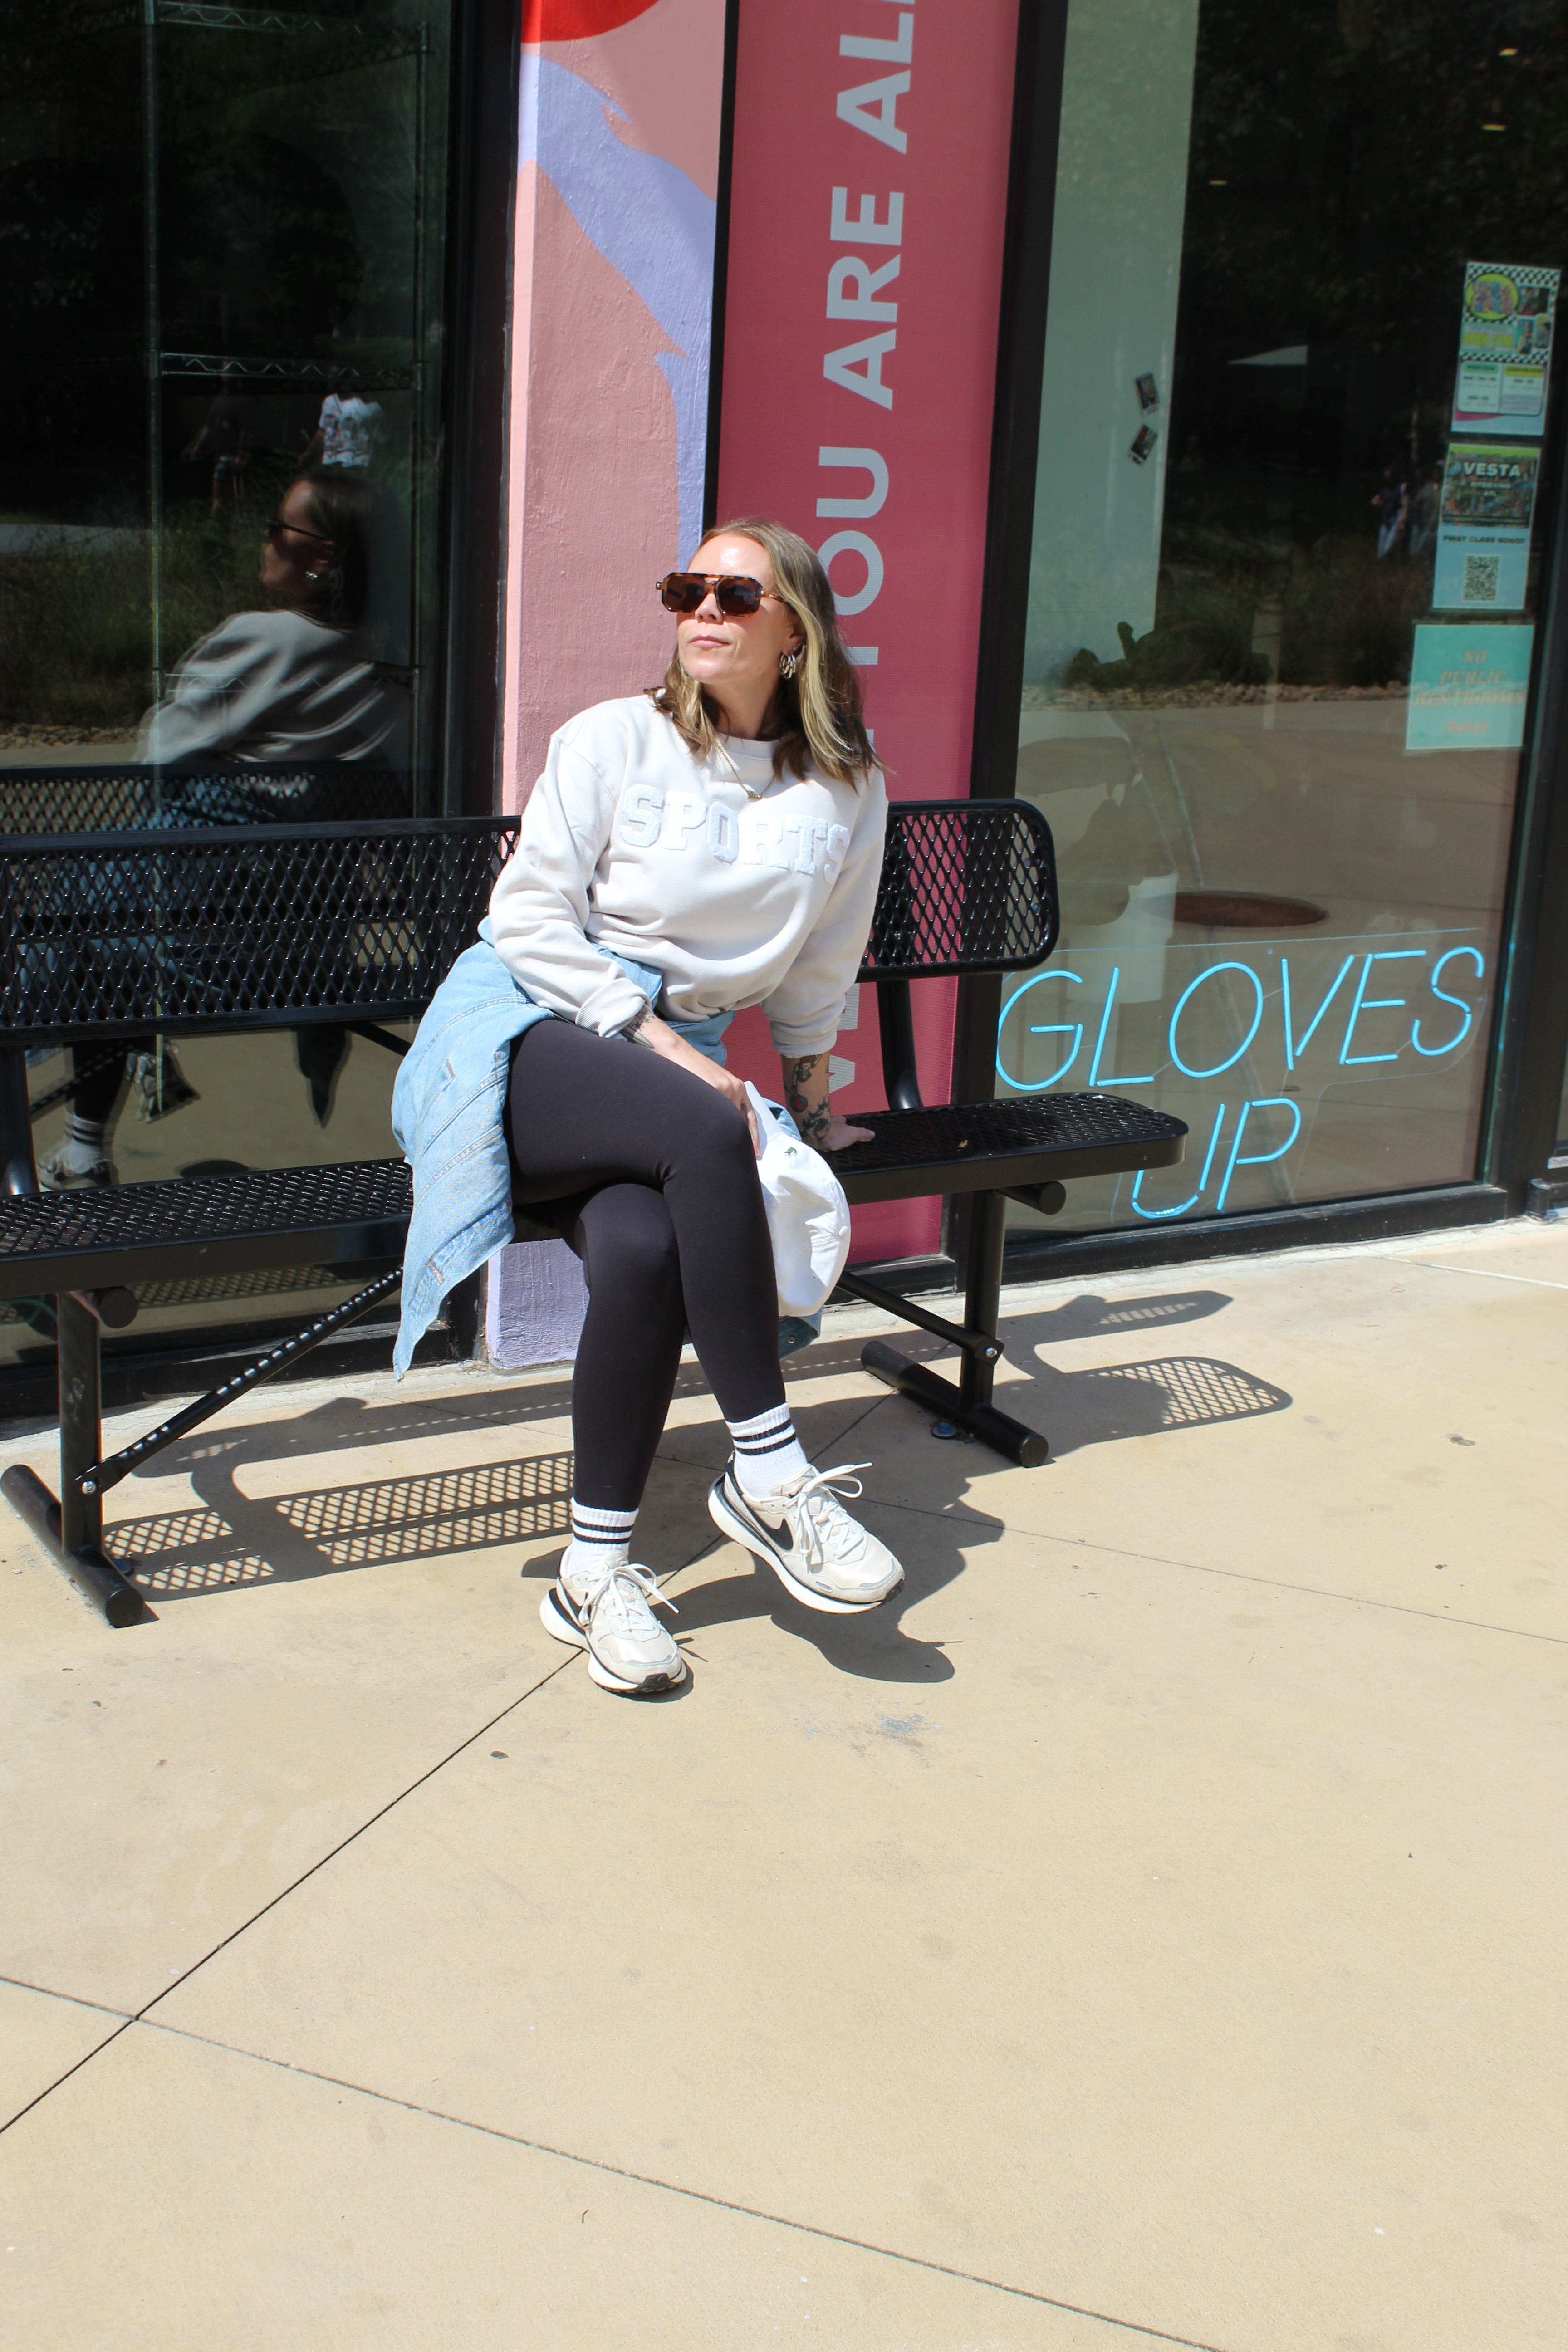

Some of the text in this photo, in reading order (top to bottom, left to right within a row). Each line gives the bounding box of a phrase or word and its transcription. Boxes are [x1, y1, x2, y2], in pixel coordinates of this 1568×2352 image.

[836, 0, 916, 155] AL
[823, 186, 905, 411] ARE
[1463, 462, 1521, 477] VESTA
[1412, 689, 1526, 707] RESTROOMS
[1437, 669, 1506, 687] PUBLIC
[1462, 650, 1488, 665] NO
[618, 783, 851, 885] SPORTS
[995, 946, 1484, 1091] GLOVES
[1132, 1097, 1301, 1219] UP
